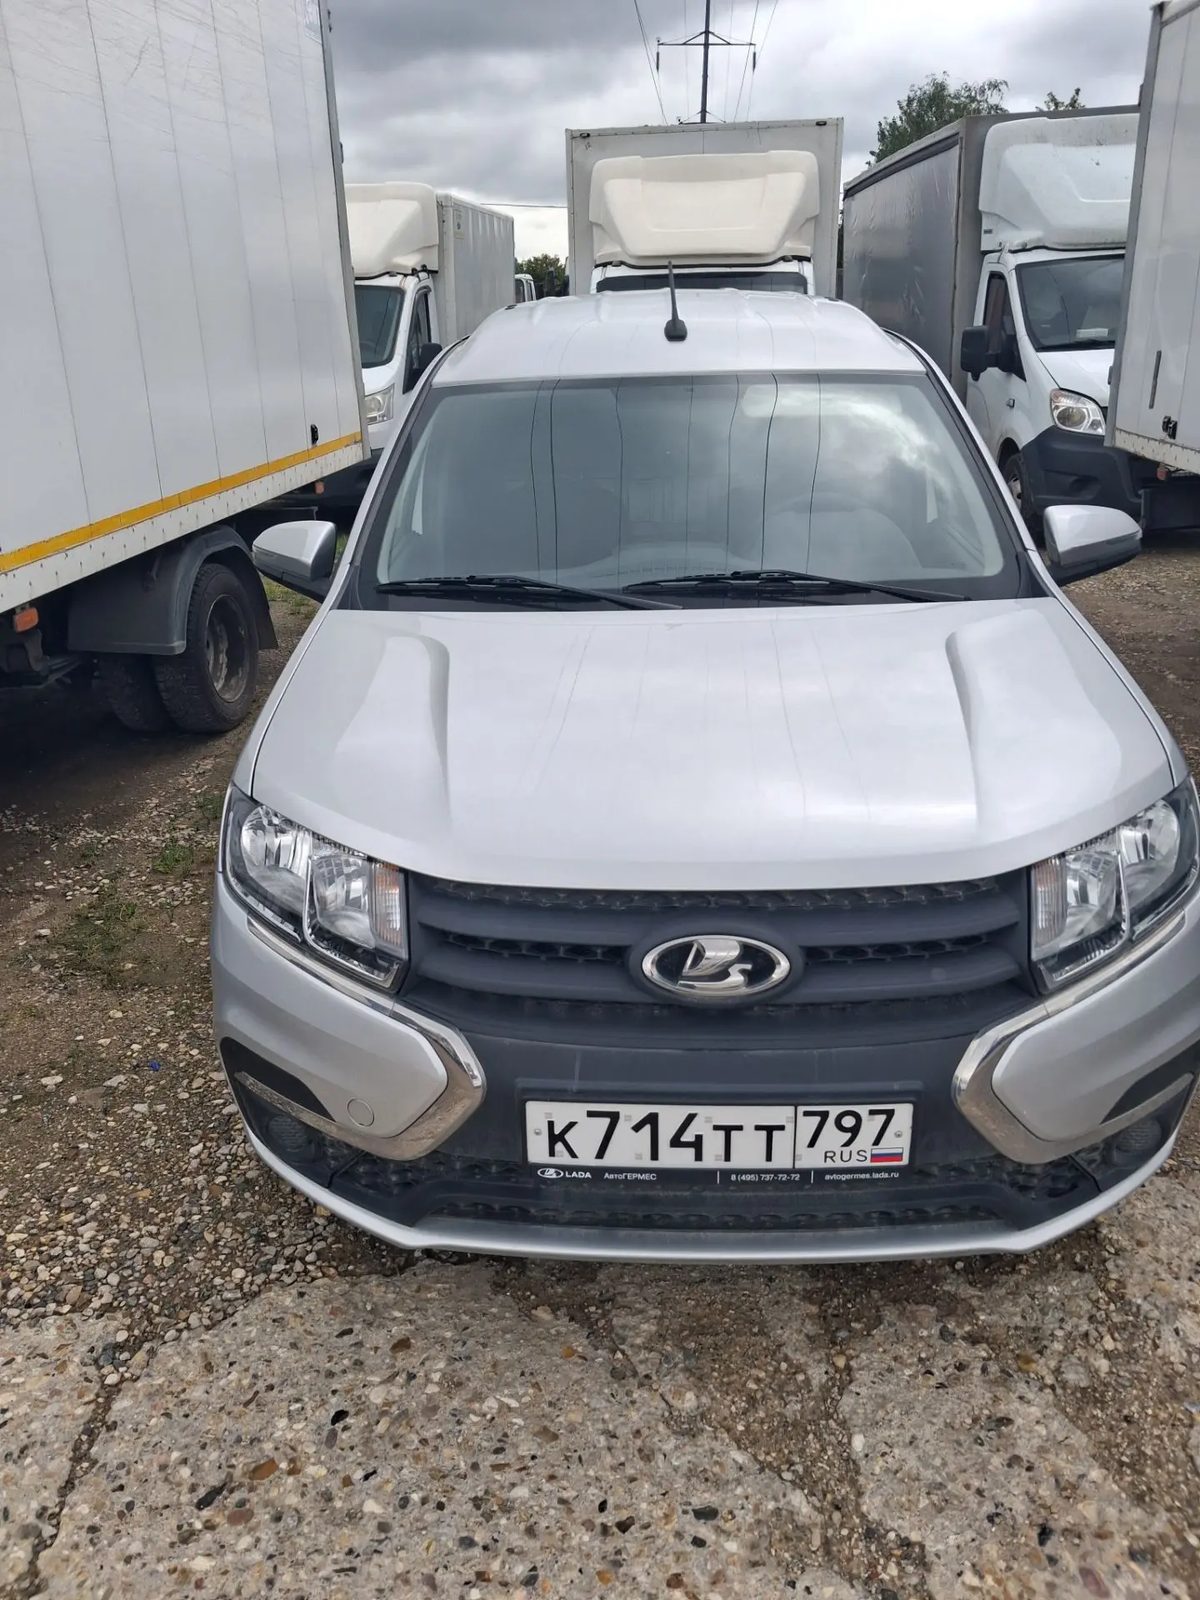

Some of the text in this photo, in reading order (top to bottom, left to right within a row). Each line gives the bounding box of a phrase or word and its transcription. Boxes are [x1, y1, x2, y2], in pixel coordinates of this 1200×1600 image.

[802, 1108, 896, 1148] 797
[547, 1110, 785, 1162] К714ТТ
[824, 1149, 868, 1163] RUS
[565, 1170, 592, 1179] LADA
[603, 1172, 657, 1181] АвтоГЕРМЕС
[730, 1173, 800, 1182] 8 (495) 737-72-72
[824, 1171, 900, 1181] avtogermes.lada.ru
